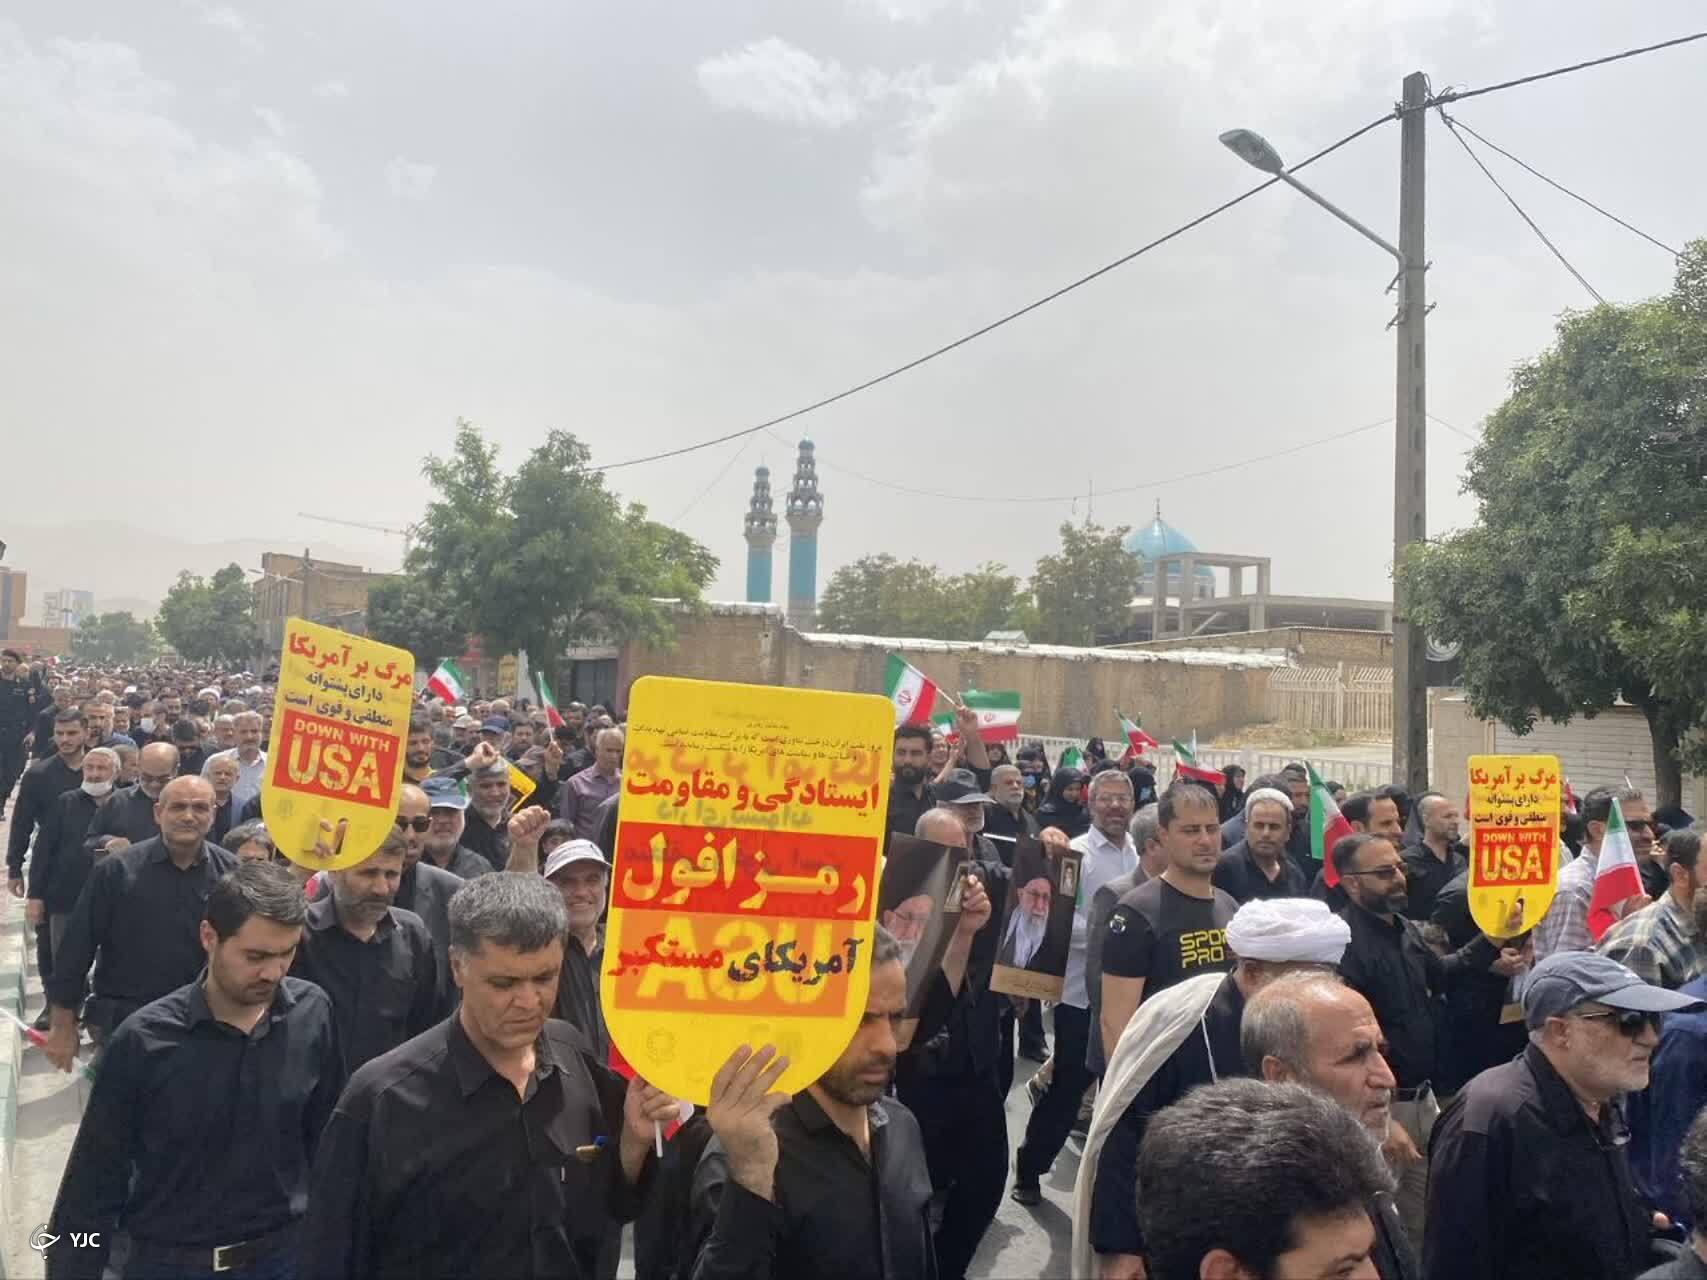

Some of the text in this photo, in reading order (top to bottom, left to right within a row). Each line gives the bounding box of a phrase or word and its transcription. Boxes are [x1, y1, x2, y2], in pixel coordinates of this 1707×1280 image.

[289, 632, 412, 689] مرگ بر آمریکا
[305, 671, 383, 701] دارای پشتوانه
[285, 692, 393, 727] منطقی و قوی است
[294, 718, 391, 752] DOWN WITH
[287, 734, 382, 800] USA
[1470, 765, 1558, 791] مرگ بر آمریکا
[626, 769, 880, 817] ایستادگی و مقاومت
[1516, 793, 1539, 808] دارای
[1474, 813, 1493, 824] است
[1482, 831, 1547, 843] DOWN WITH
[622, 831, 867, 914] رمز افول
[1481, 843, 1544, 882] USA
[607, 934, 865, 986] آمریکای مستکبر
[1182, 946, 1225, 968] PRO
